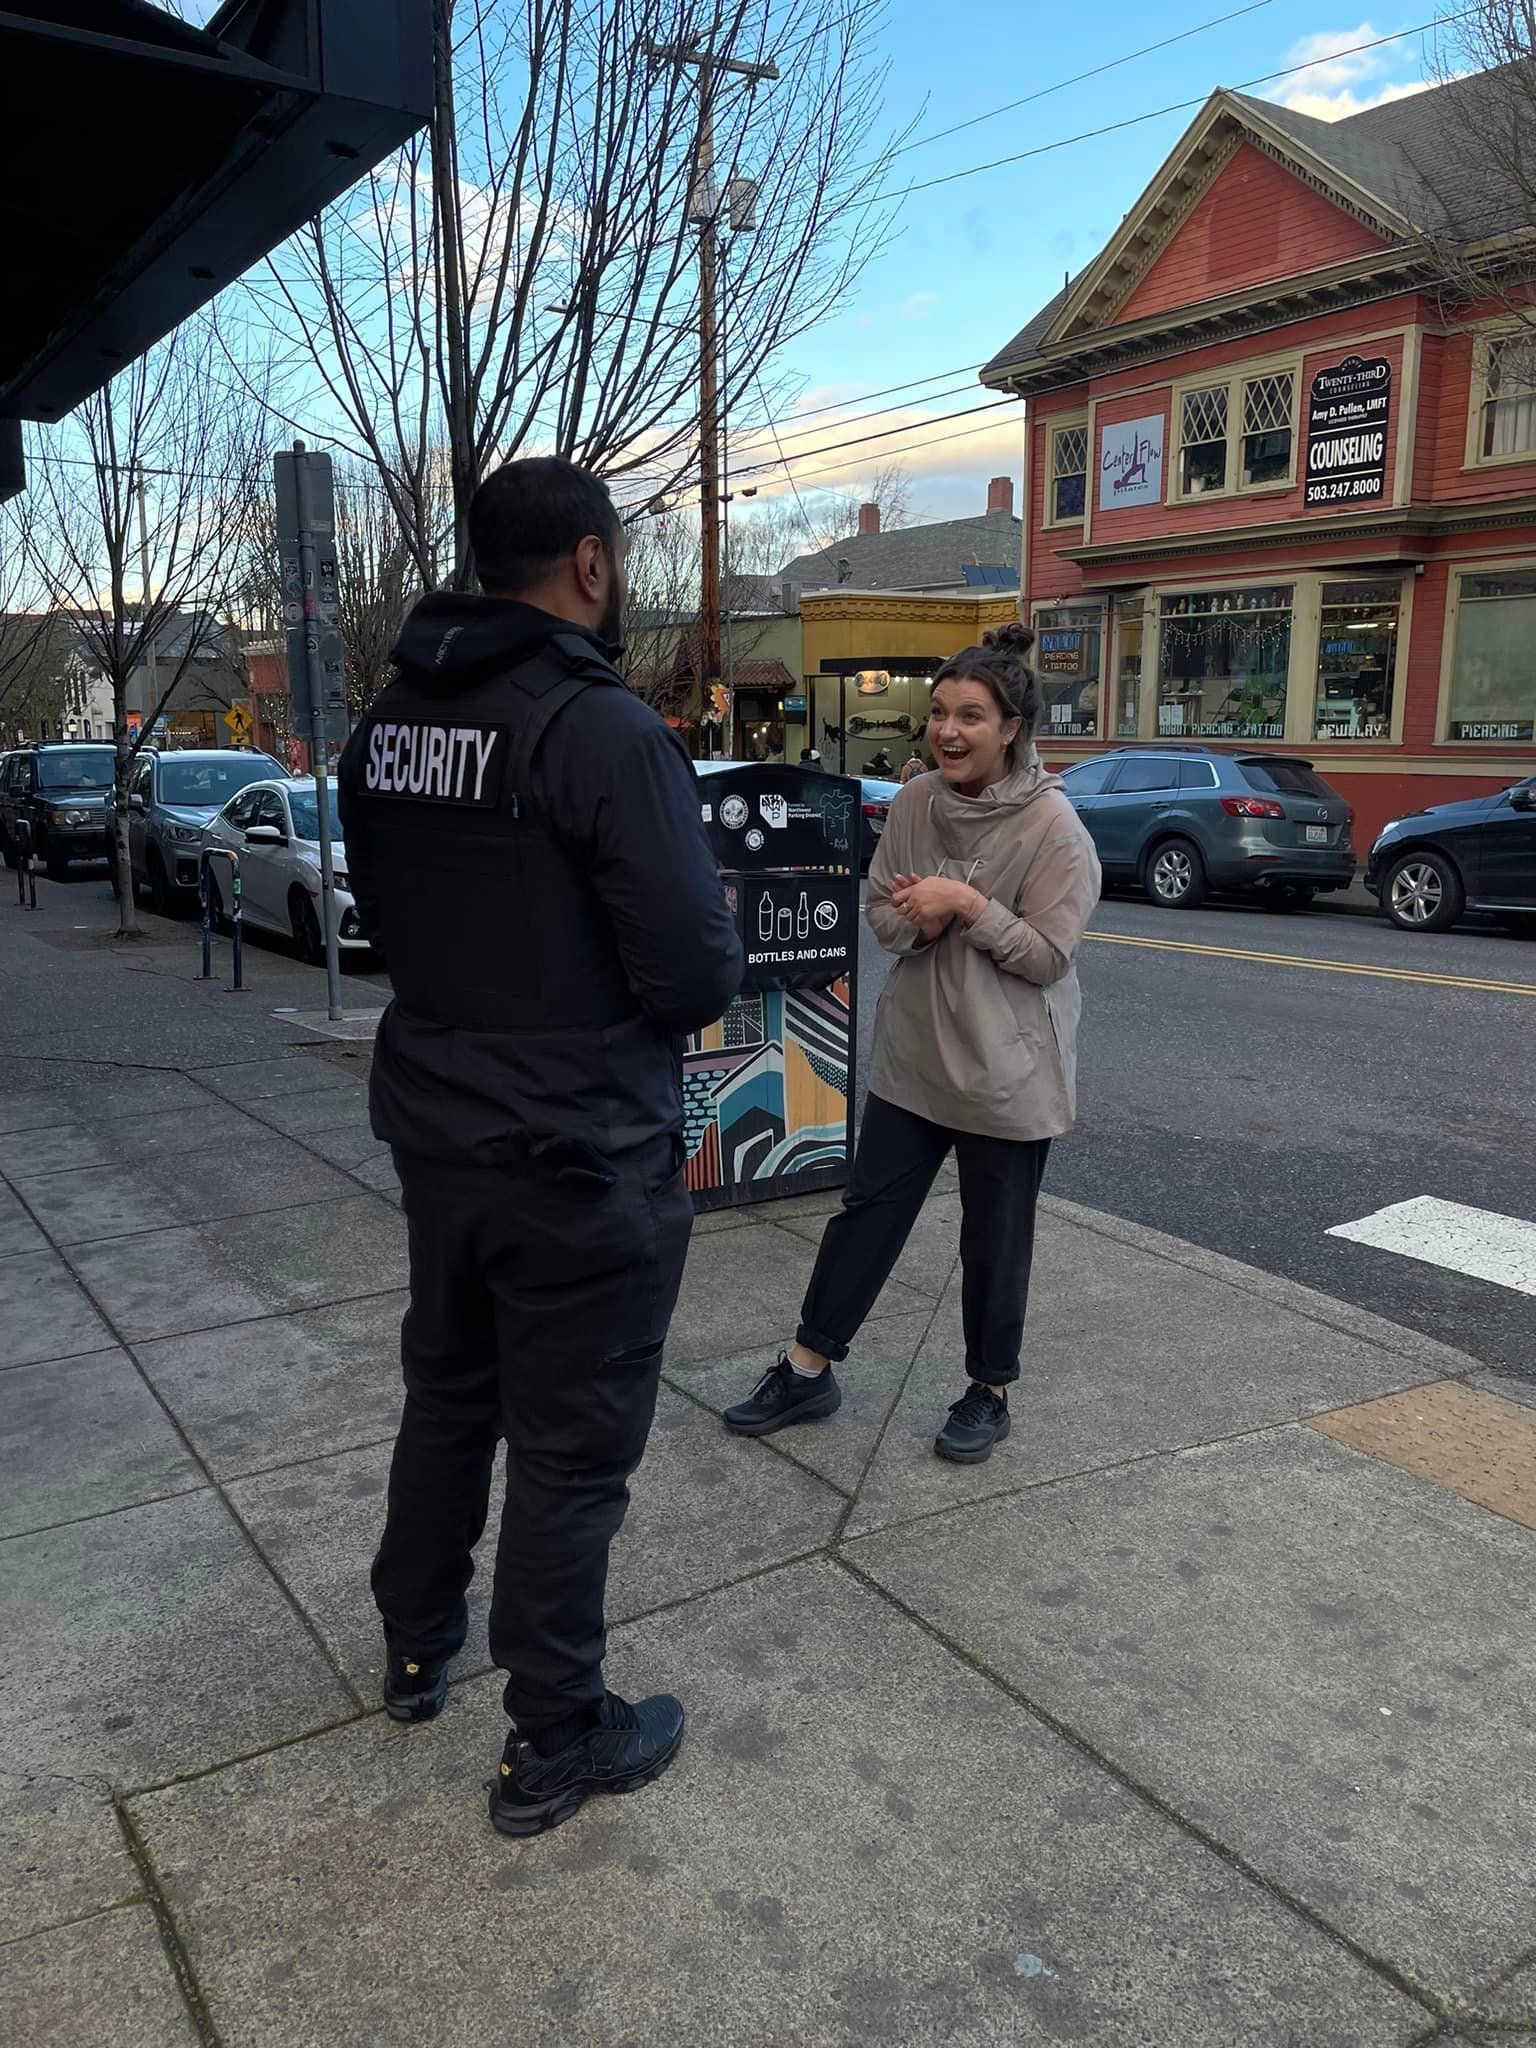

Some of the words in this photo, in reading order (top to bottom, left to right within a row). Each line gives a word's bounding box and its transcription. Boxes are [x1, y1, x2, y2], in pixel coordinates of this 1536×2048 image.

[1312, 410, 1328, 421] Amy
[1329, 407, 1337, 417] D.
[1339, 402, 1365, 416] Pullen,
[1366, 397, 1387, 410] LMFT
[1103, 444, 1133, 474] Center
[1140, 440, 1162, 464] Flow
[1309, 432, 1383, 470] COUNSELING
[1307, 478, 1380, 502] 503.247.8000
[1050, 662, 1079, 671] TATTOO
[1054, 723, 1082, 734] TATTOO
[1191, 723, 1233, 735] PIERCING
[1243, 723, 1283, 736] TATTOO
[1461, 724, 1518, 738] PIERCING
[365, 723, 498, 800] SECURITY
[748, 951, 795, 964] BOTTLES
[796, 949, 818, 960] AND
[819, 946, 847, 958] CANS
